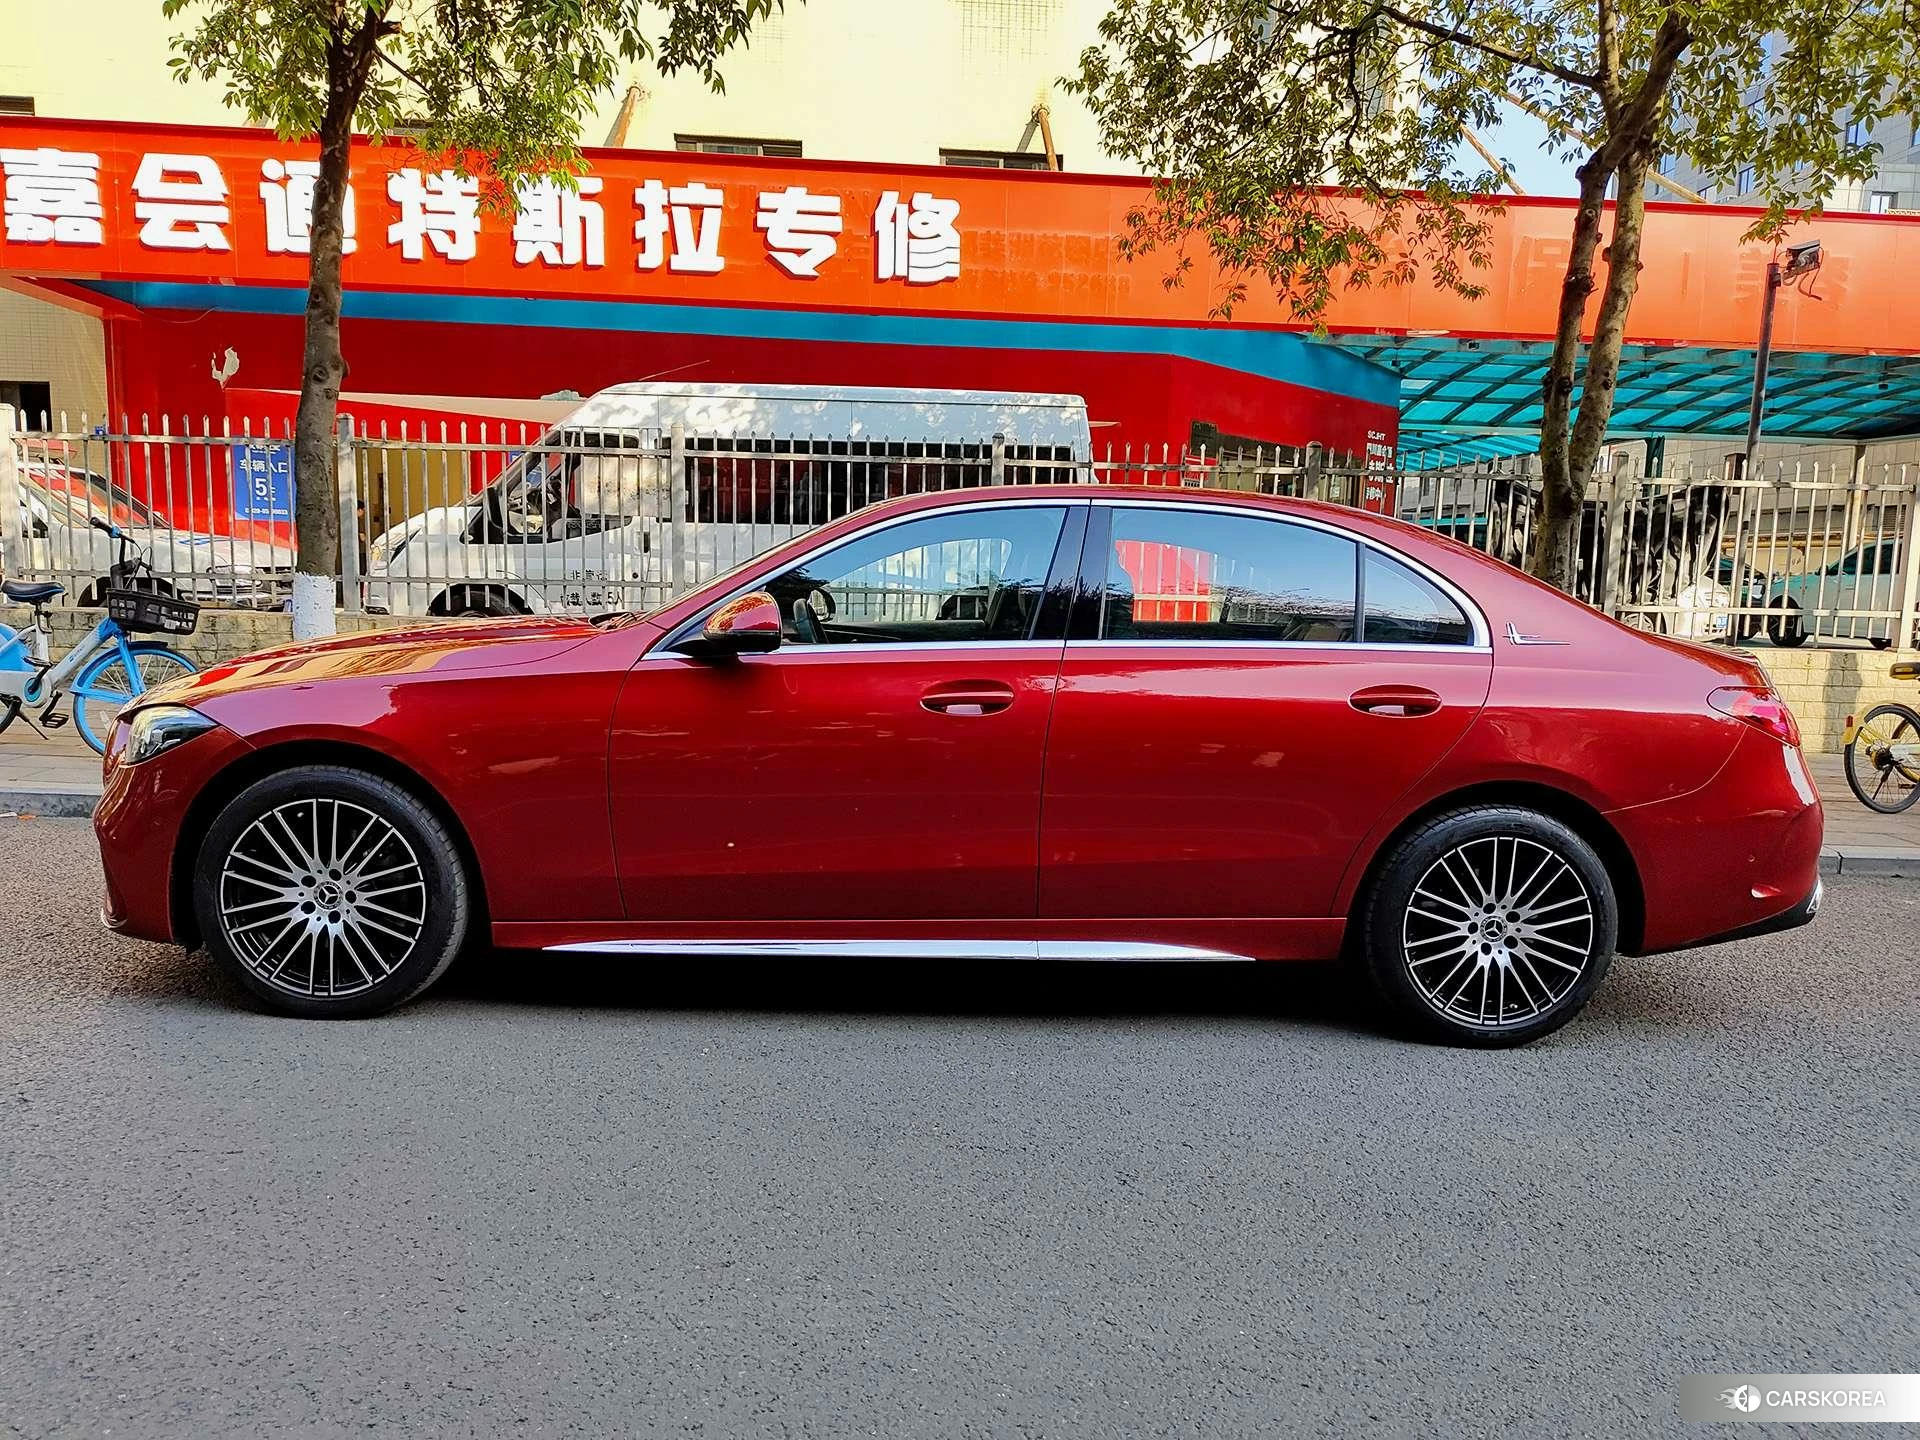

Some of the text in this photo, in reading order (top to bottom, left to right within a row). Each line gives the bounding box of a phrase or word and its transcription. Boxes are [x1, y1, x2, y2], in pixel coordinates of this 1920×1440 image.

[0, 147, 961, 283] 嘉会通特斯拉专修
